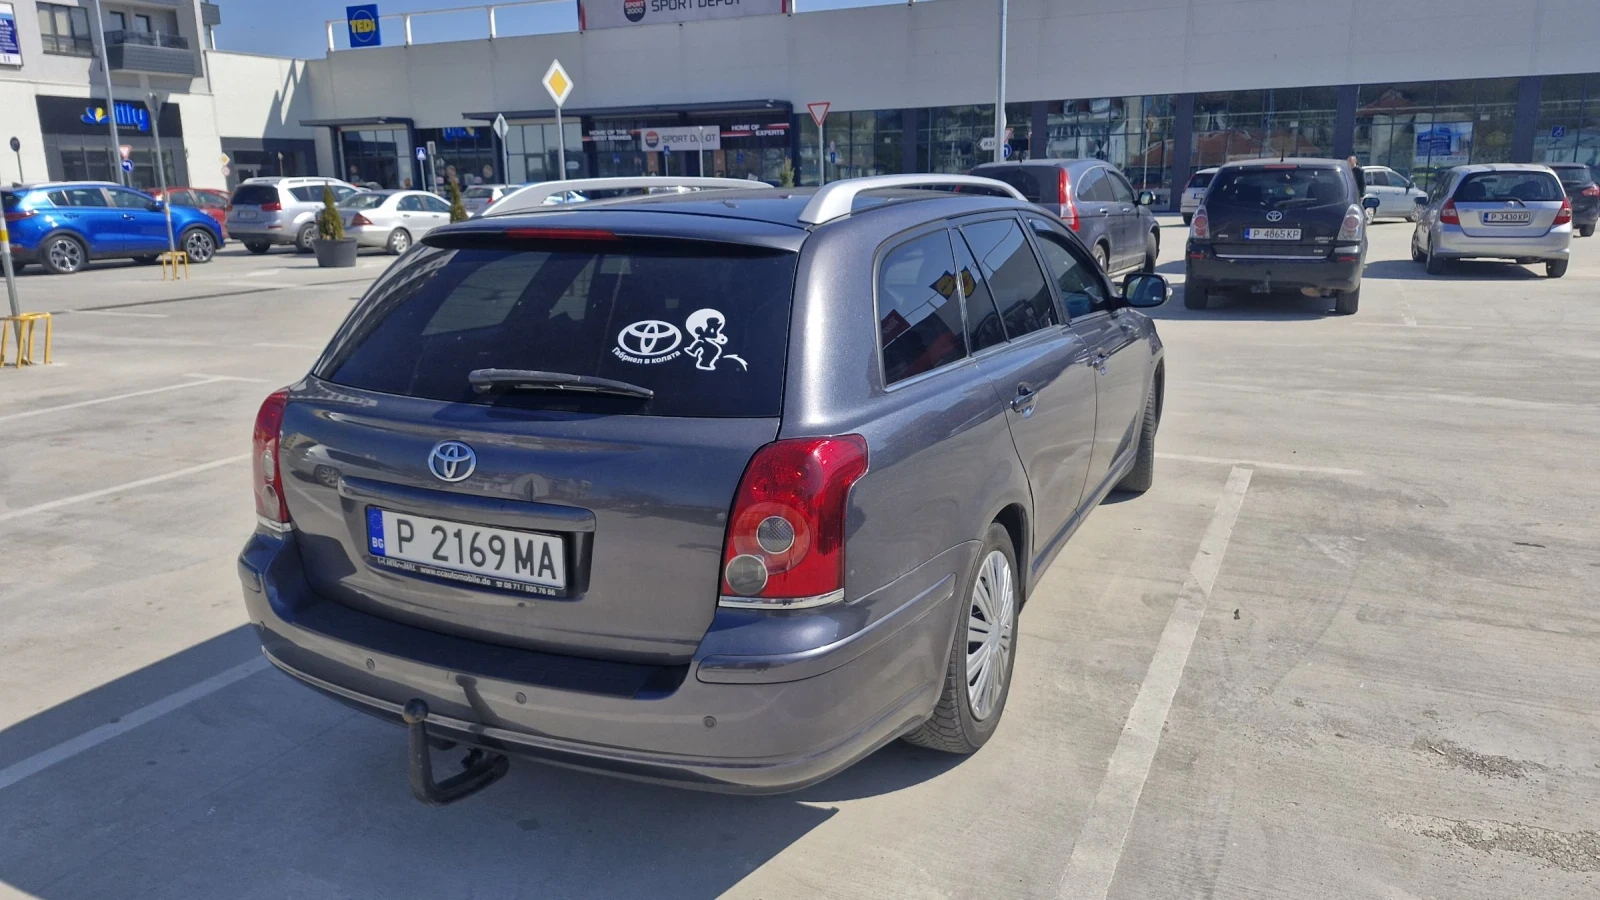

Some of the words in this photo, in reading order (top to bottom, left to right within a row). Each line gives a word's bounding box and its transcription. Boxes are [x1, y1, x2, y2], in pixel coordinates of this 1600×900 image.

[651, 0, 692, 12] SPORT
[661, 134, 688, 143] SPORT
[690, 133, 716, 142] DOT
[372, 536, 385, 548] BG
[396, 518, 415, 554] P
[420, 566, 491, 586] www.ccautomobile.de
